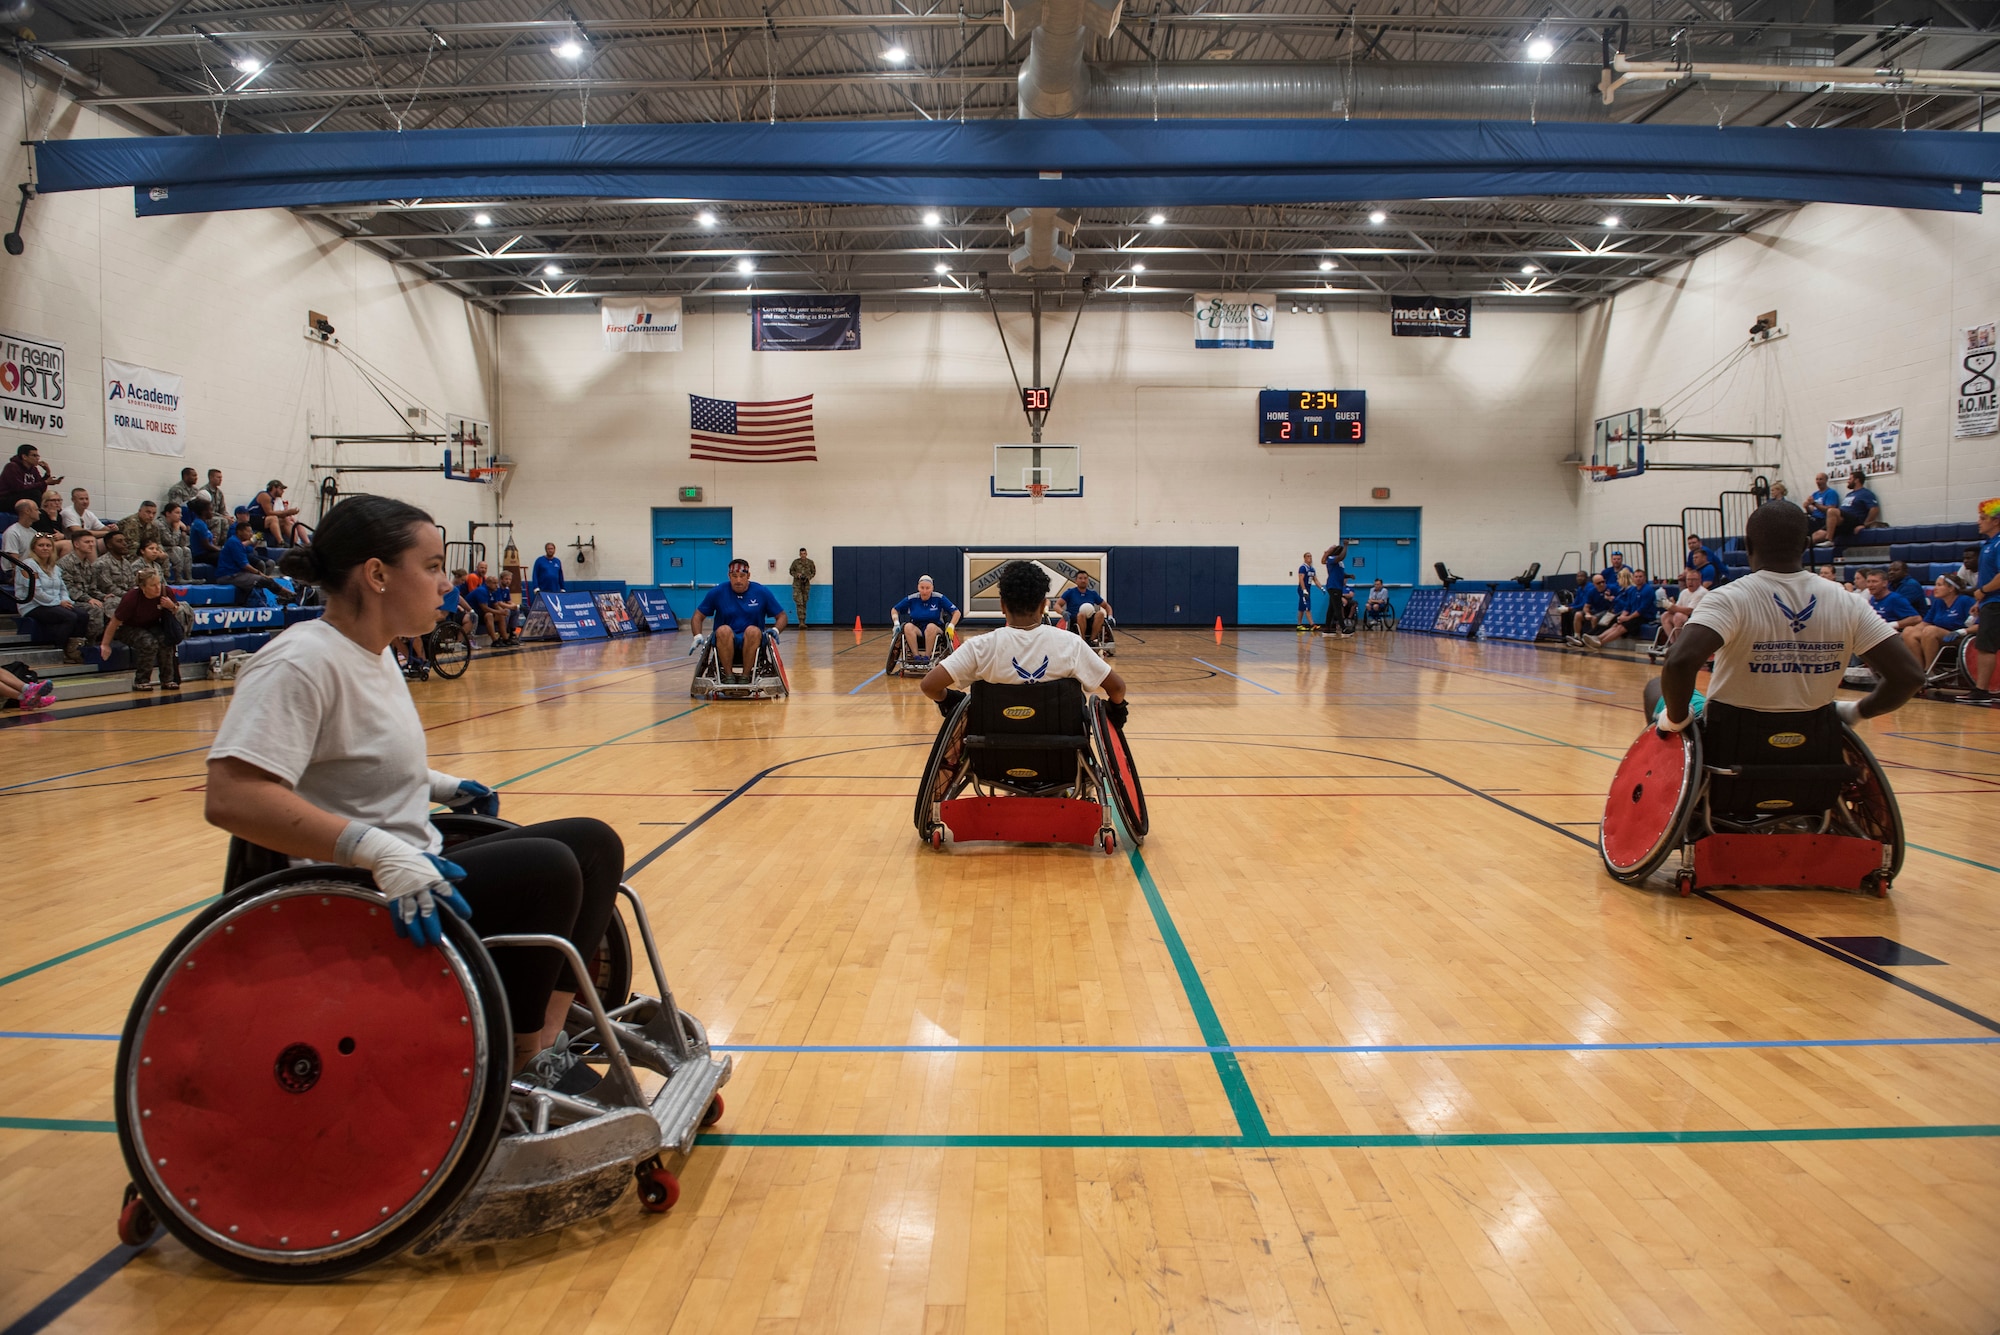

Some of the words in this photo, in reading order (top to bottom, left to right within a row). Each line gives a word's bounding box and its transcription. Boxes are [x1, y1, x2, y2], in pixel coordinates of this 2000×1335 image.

[1210, 298, 1250, 311] SCOTT
[1197, 308, 1243, 321] CREDIT
[1394, 307, 1466, 321] metroPCS
[1208, 317, 1249, 328] UNION
[7, 342, 19, 361] IT
[21, 346, 60, 371] AGAIN
[127, 383, 179, 411] Academy
[1027, 390, 1048, 408] 30
[1300, 392, 1338, 410] 2:34
[4, 405, 17, 422] W
[20, 408, 46, 430] Hwy
[49, 414, 64, 429] 50
[1266, 412, 1289, 420] HOME
[1335, 412, 1361, 420] GUEST
[114, 414, 130, 428] FOR
[130, 417, 145, 430] ALL.
[146, 420, 160, 433] FOR
[160, 422, 178, 435] LESS.
[1281, 422, 1291, 439] 2
[1313, 424, 1318, 437] 1
[1351, 422, 1362, 439] 3
[1056, 562, 1097, 590] SPOS
[1797, 642, 1845, 651] WARRIOR
[1748, 661, 1841, 674] VOLUNTEER
